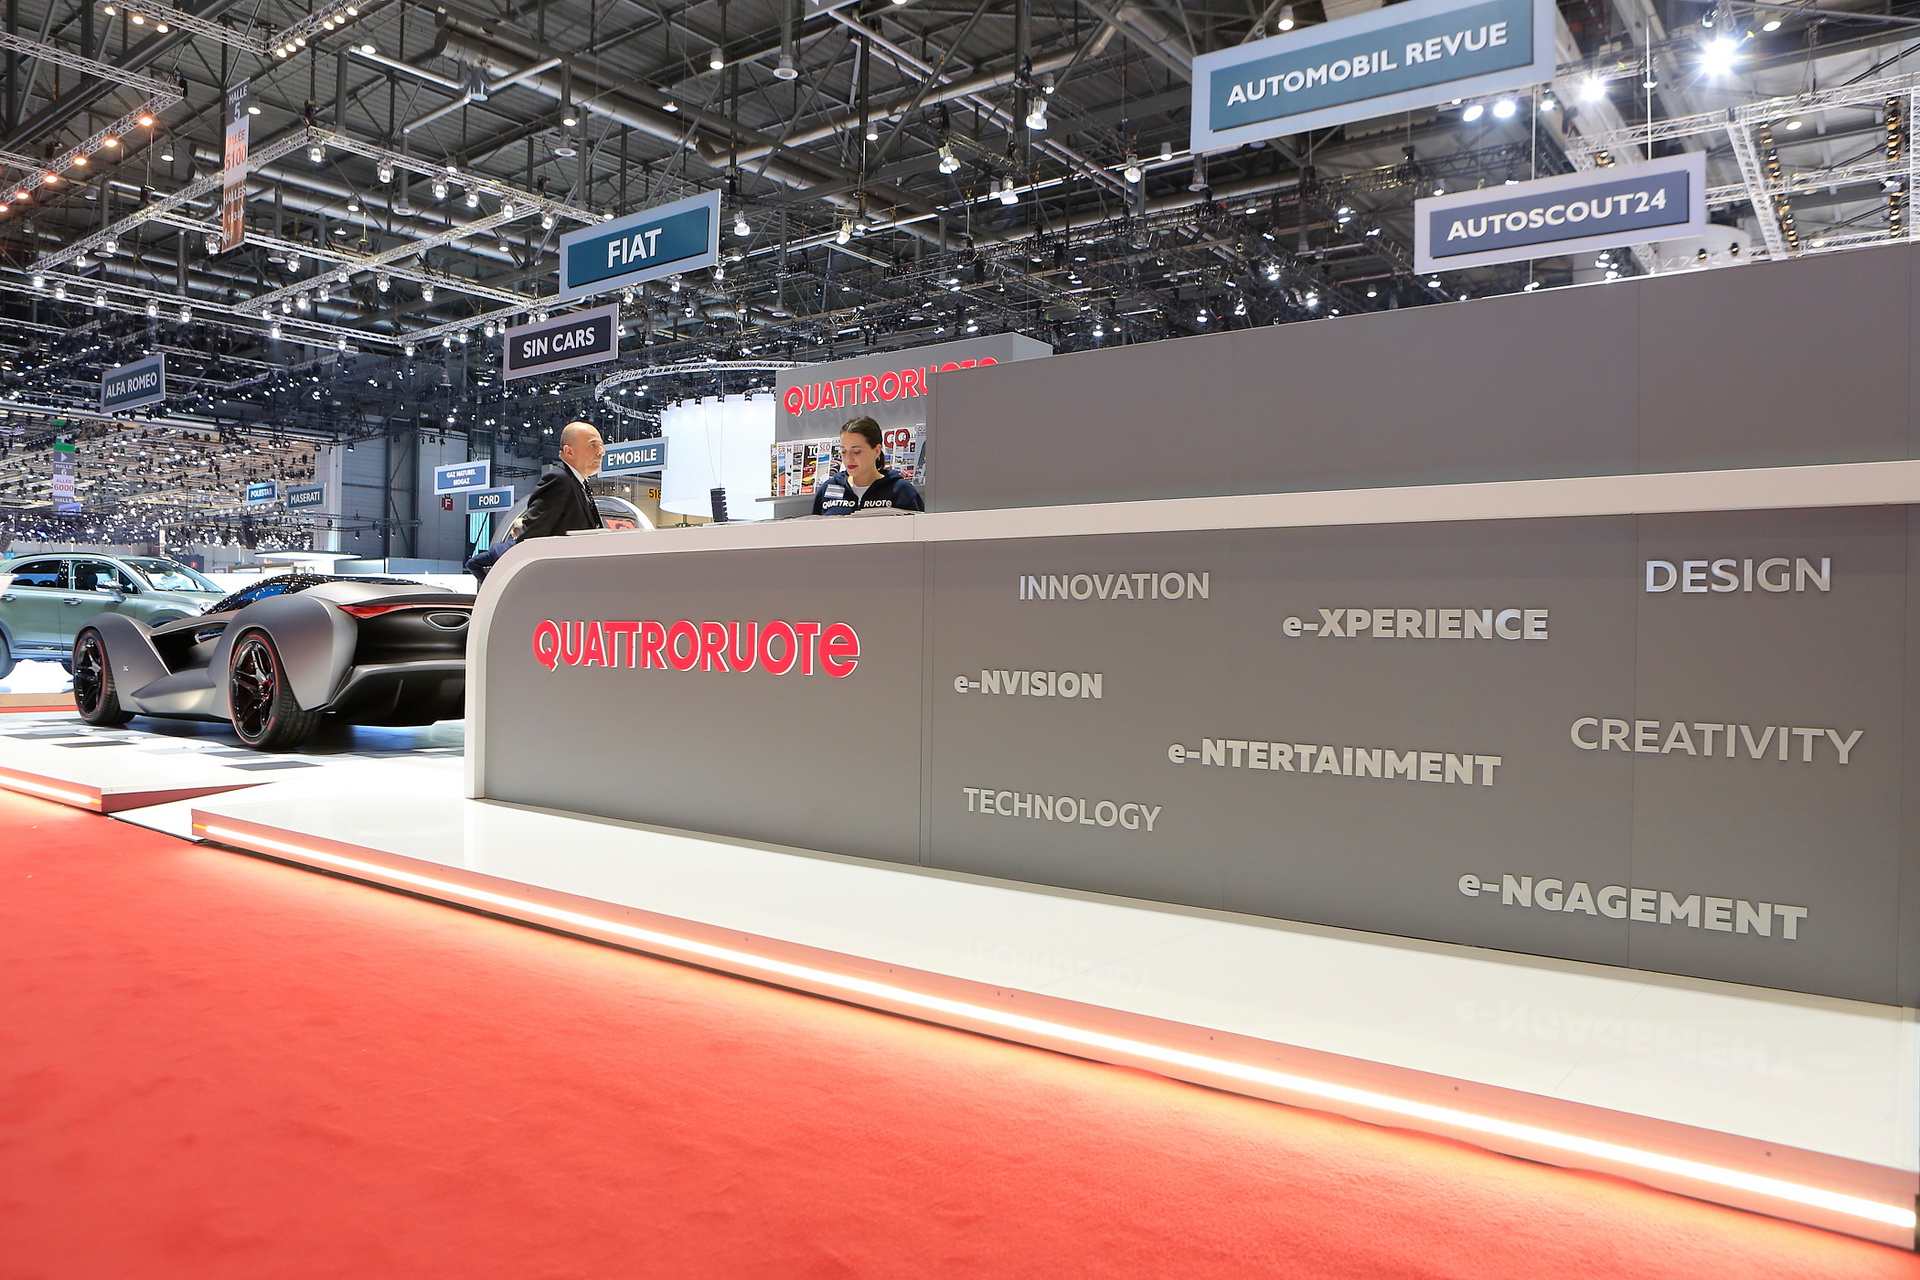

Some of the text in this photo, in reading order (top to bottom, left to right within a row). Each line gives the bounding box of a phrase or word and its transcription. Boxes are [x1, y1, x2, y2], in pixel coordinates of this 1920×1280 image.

[1227, 21, 1508, 107] AUTOMOBIL REVUE
[228, 85, 248, 105] HALLE
[234, 102, 241, 122] 5
[225, 145, 247, 172] 5100
[1446, 188, 1668, 242] AUTOSCOUT24
[607, 227, 663, 268] FIAT
[522, 326, 596, 359] SIN CARS
[106, 372, 158, 399] ALFA ROMEO
[607, 448, 657, 467] E'MOBILE
[53, 484, 74, 492] 6000
[446, 469, 477, 478] GAZ NATUREL
[250, 488, 273, 498] POLESTAR
[290, 491, 320, 504] MASERATI
[478, 494, 500, 506] FORD
[822, 499, 856, 509] QUATTRO
[1018, 571, 1210, 601] INNOVATION
[1645, 556, 1831, 594] DESIGN
[1282, 607, 1549, 641] e-XPERIENCE
[953, 669, 1103, 699] e-NVISION
[1570, 716, 1864, 765] CREATIVITY
[1167, 738, 1502, 787] e-NTERTAINMENT
[963, 786, 1162, 832] TECHNOLOGY
[1458, 871, 1808, 941] e-NGAGEMENT
